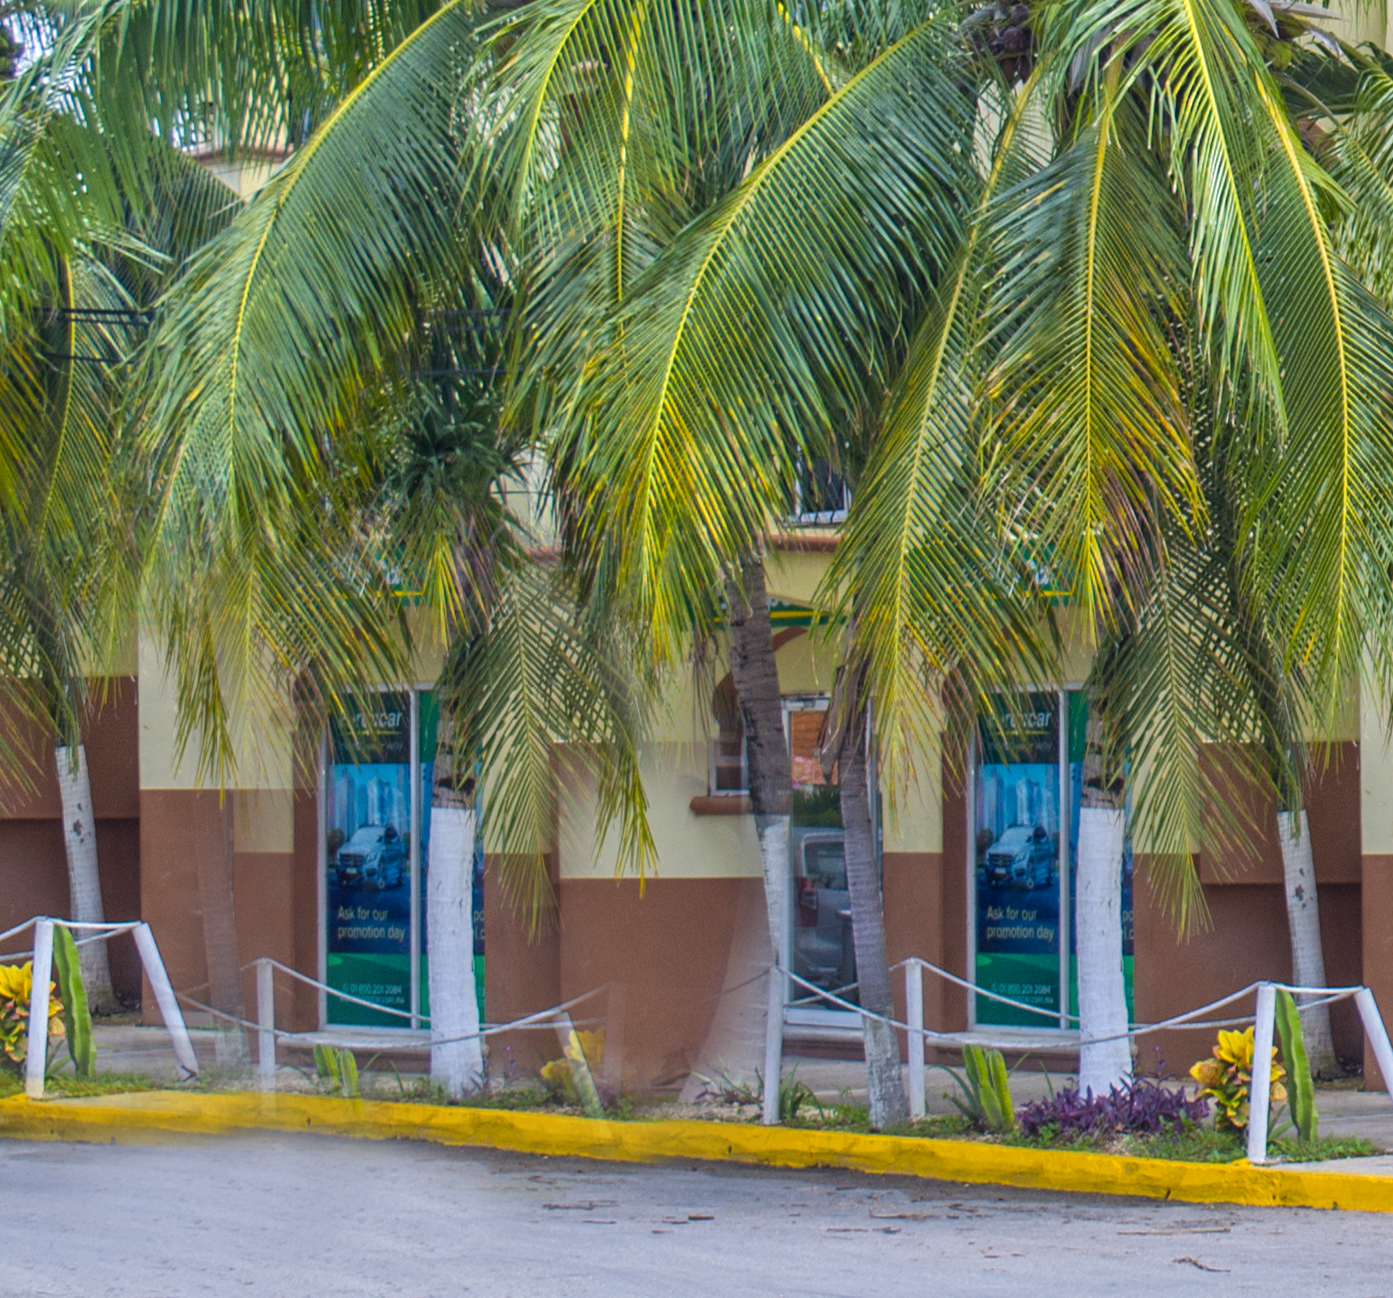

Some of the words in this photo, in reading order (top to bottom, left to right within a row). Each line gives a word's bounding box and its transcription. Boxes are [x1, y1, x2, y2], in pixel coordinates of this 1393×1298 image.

[338, 906, 355, 919] Ask
[357, 906, 370, 920] for
[372, 909, 388, 920] our
[987, 906, 1004, 919] Ask
[1006, 906, 1019, 920] for
[1021, 909, 1037, 920] our
[338, 925, 385, 940] promotion
[387, 925, 405, 942] day
[987, 925, 1034, 940] promotion
[1036, 925, 1055, 942] day
